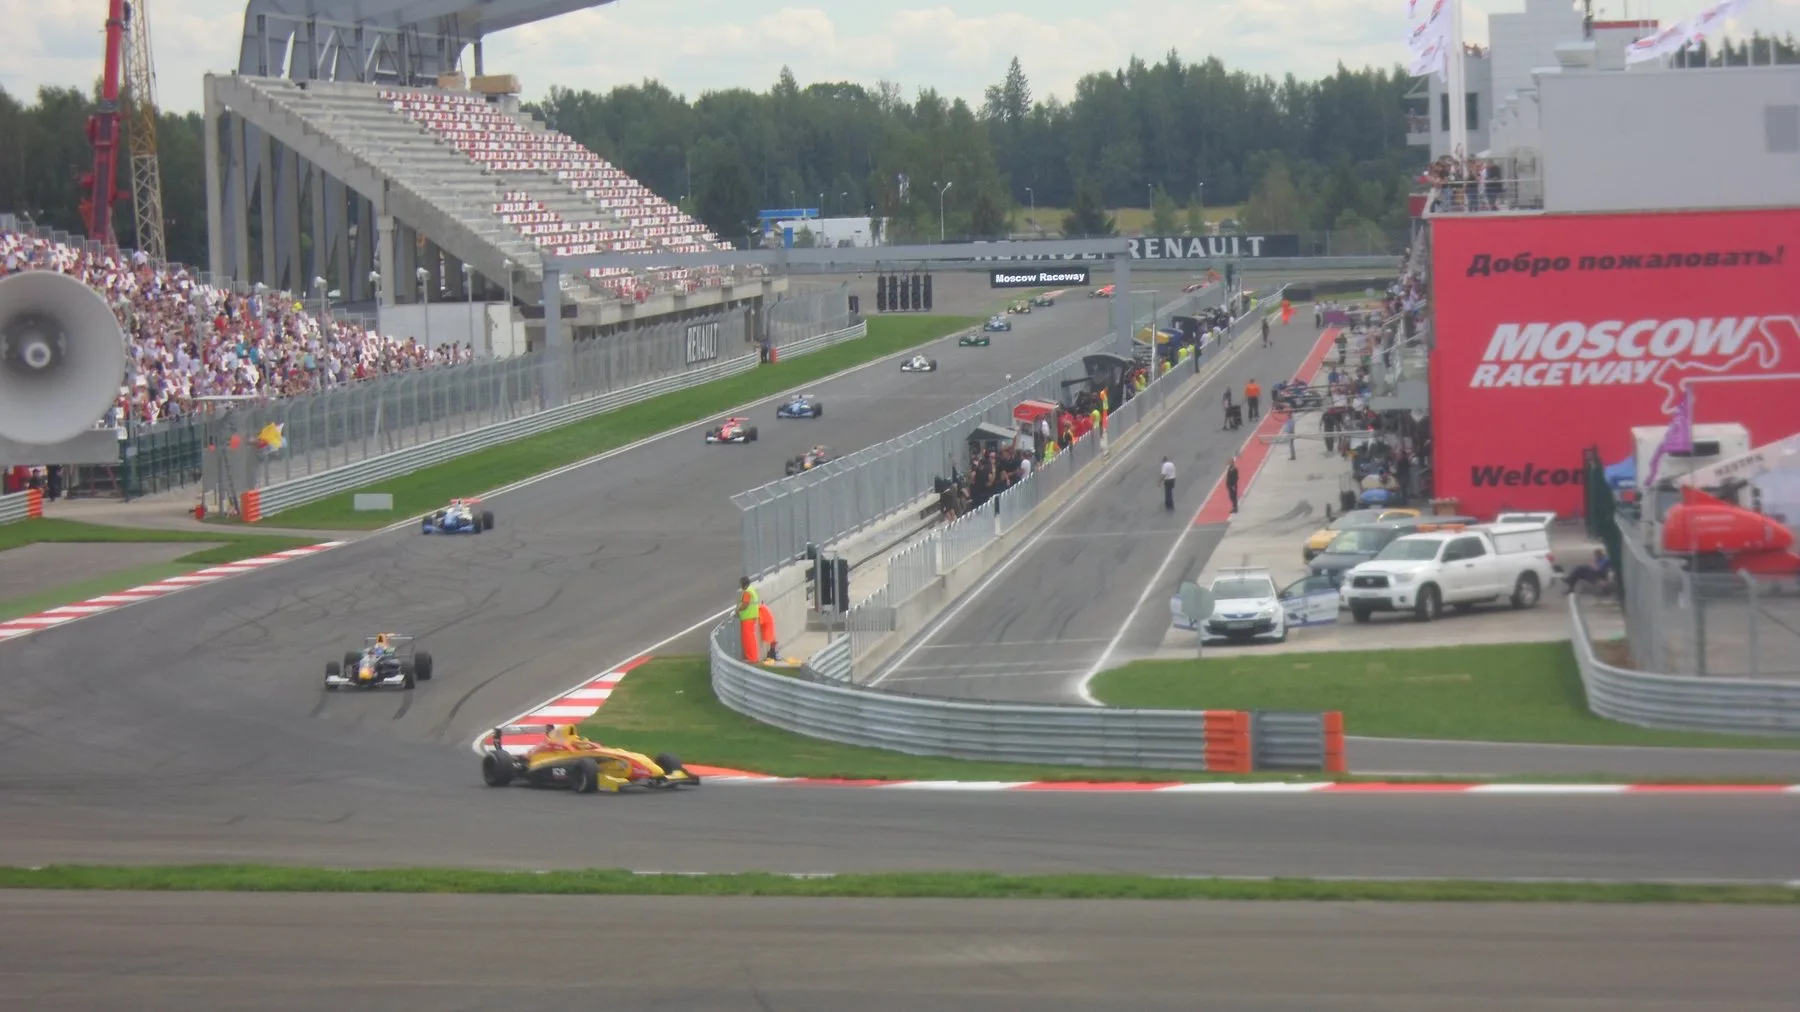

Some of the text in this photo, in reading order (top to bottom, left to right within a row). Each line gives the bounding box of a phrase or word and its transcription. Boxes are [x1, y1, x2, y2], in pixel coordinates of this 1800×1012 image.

[1128, 237, 1264, 258] RENAULT
[1467, 246, 1785, 277] Добро пожаловать!
[995, 271, 1085, 283] Moscow Raceway
[687, 323, 717, 363] RENAULT
[1482, 316, 1757, 361] MOSCOW
[1469, 361, 1660, 388] RACEWAY
